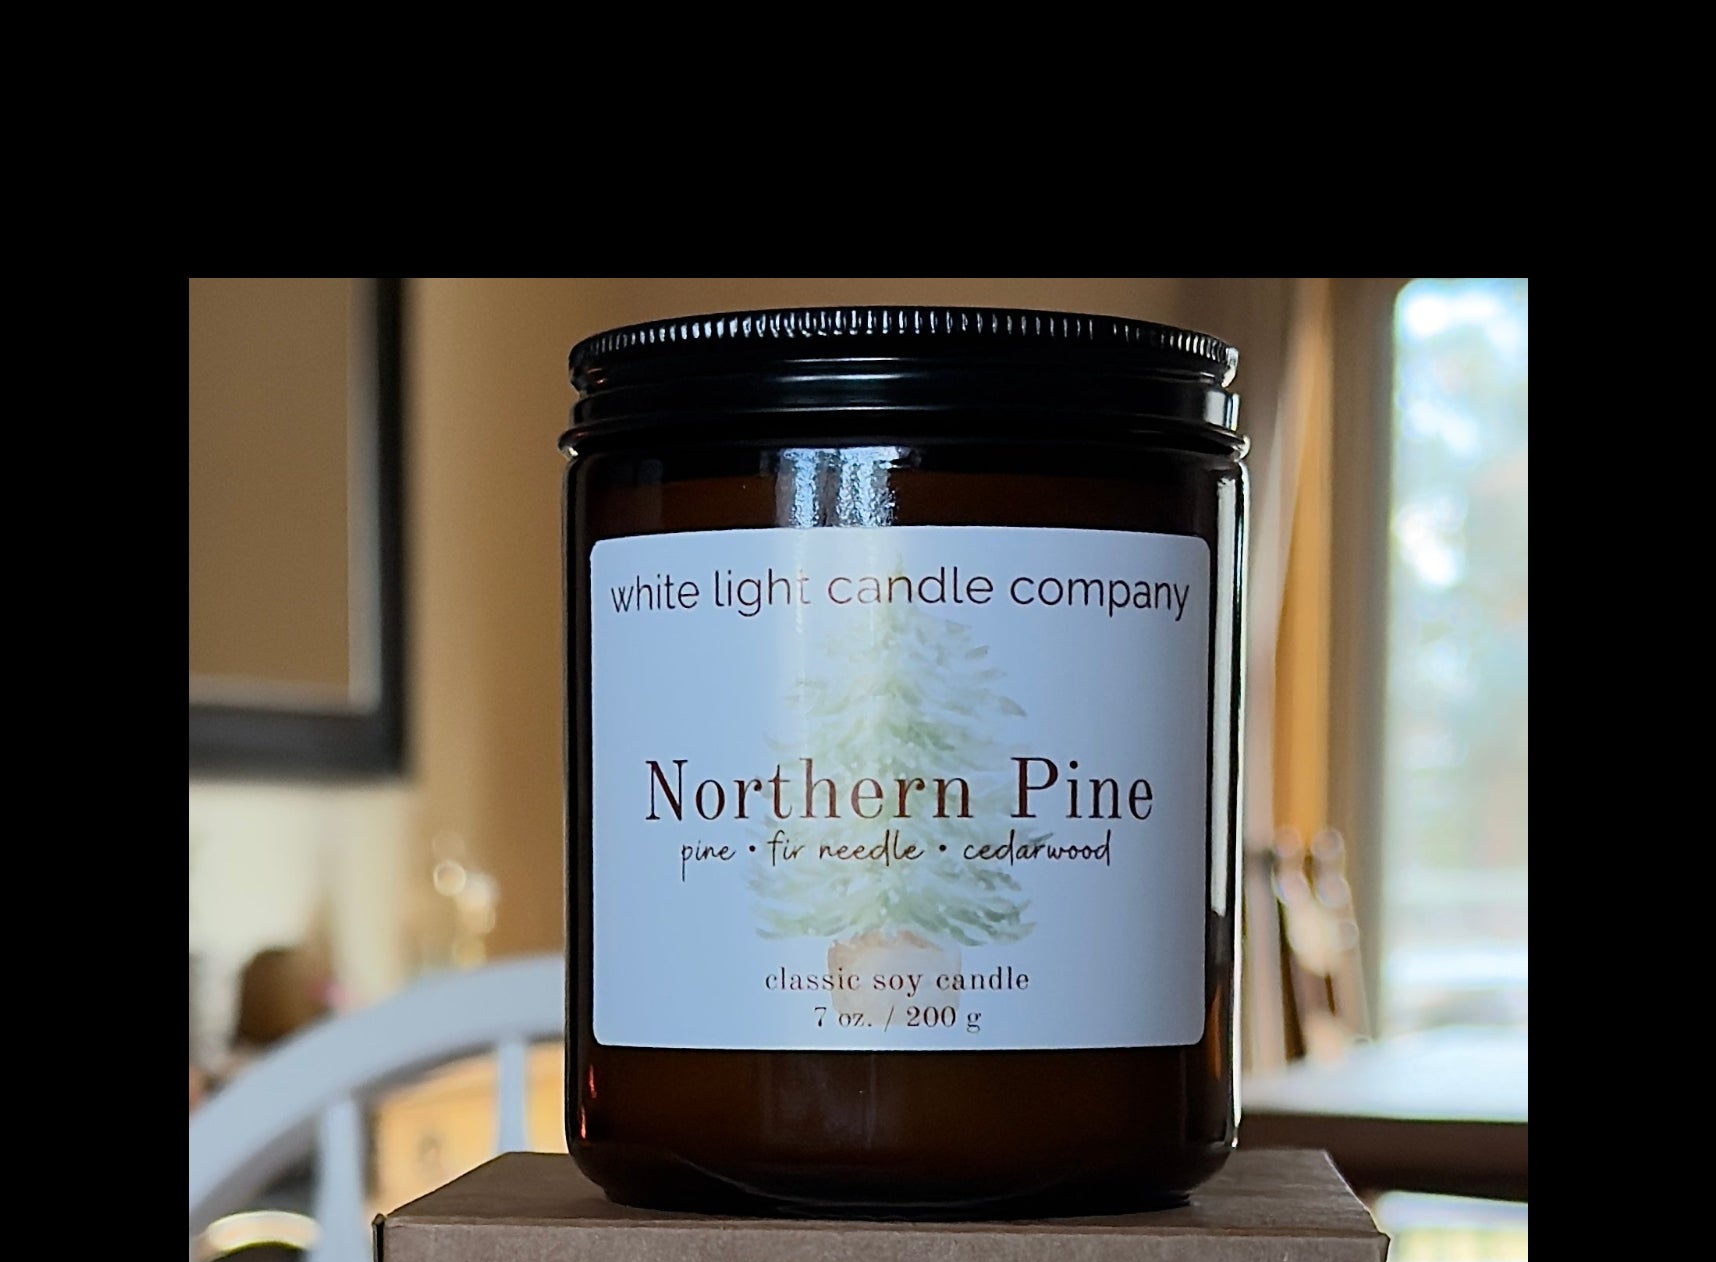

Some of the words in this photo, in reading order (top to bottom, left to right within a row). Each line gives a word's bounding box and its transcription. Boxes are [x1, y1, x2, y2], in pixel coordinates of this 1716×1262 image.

[610, 573, 699, 613] white
[715, 569, 810, 617] light
[827, 567, 994, 605] candle
[1010, 576, 1190, 621] company
[645, 758, 974, 822] Northern
[1010, 757, 1153, 821] Pine
[681, 840, 736, 881] pine
[767, 830, 804, 866] fir
[819, 831, 925, 867] needle
[963, 830, 1112, 867] cedarwood
[765, 967, 861, 991] classic
[873, 972, 923, 997] soy
[936, 967, 1030, 991] candle
[814, 1006, 825, 1028] 7
[839, 1011, 873, 1028] oz.
[906, 1006, 956, 1028] 200
[967, 1011, 982, 1032] g
